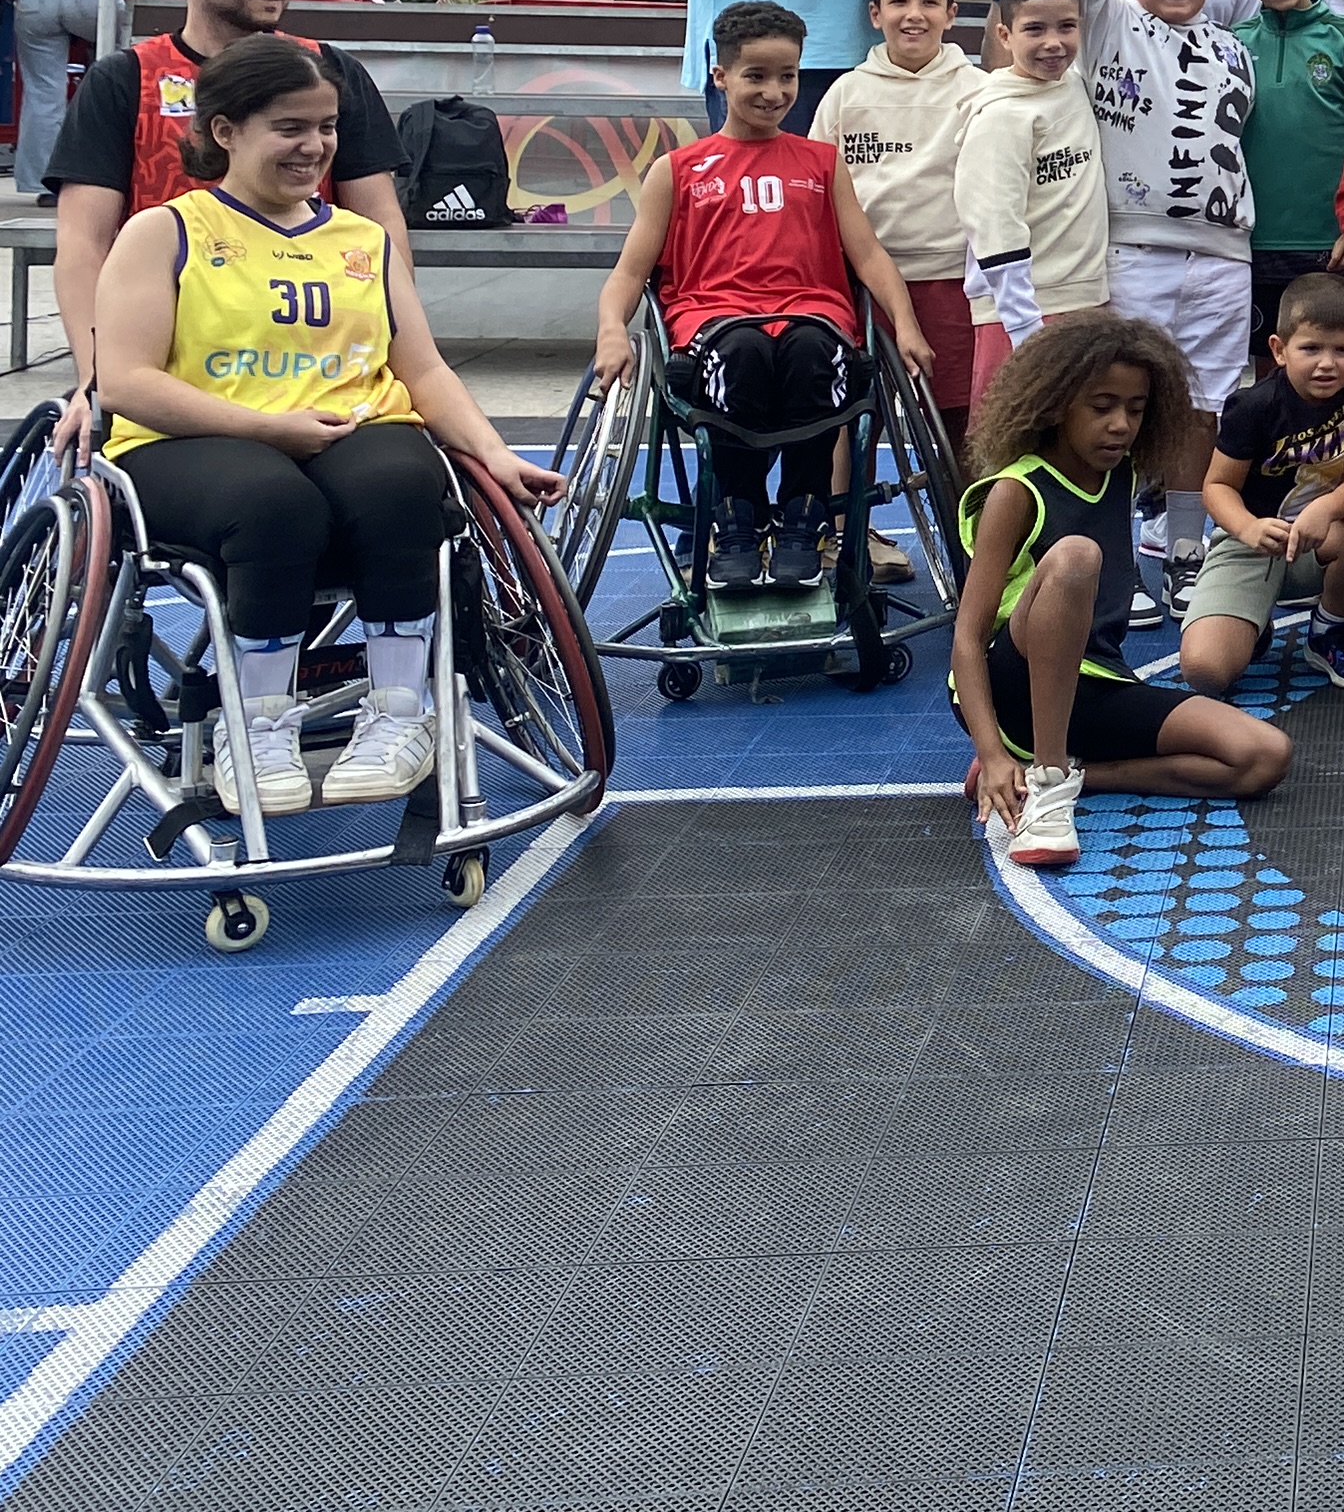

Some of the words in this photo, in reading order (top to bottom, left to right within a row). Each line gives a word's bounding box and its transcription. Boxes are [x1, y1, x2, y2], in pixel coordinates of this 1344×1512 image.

[1100, 66, 1148, 83] GREAT
[1095, 82, 1128, 110] DAY
[1130, 94, 1154, 117] IS
[1093, 104, 1136, 134] COMING
[843, 131, 880, 144] WISE
[844, 142, 914, 155] MEMBERS
[1036, 146, 1072, 164] WISE
[740, 175, 785, 215] 10
[425, 207, 486, 221] adidas
[269, 279, 331, 328] 30
